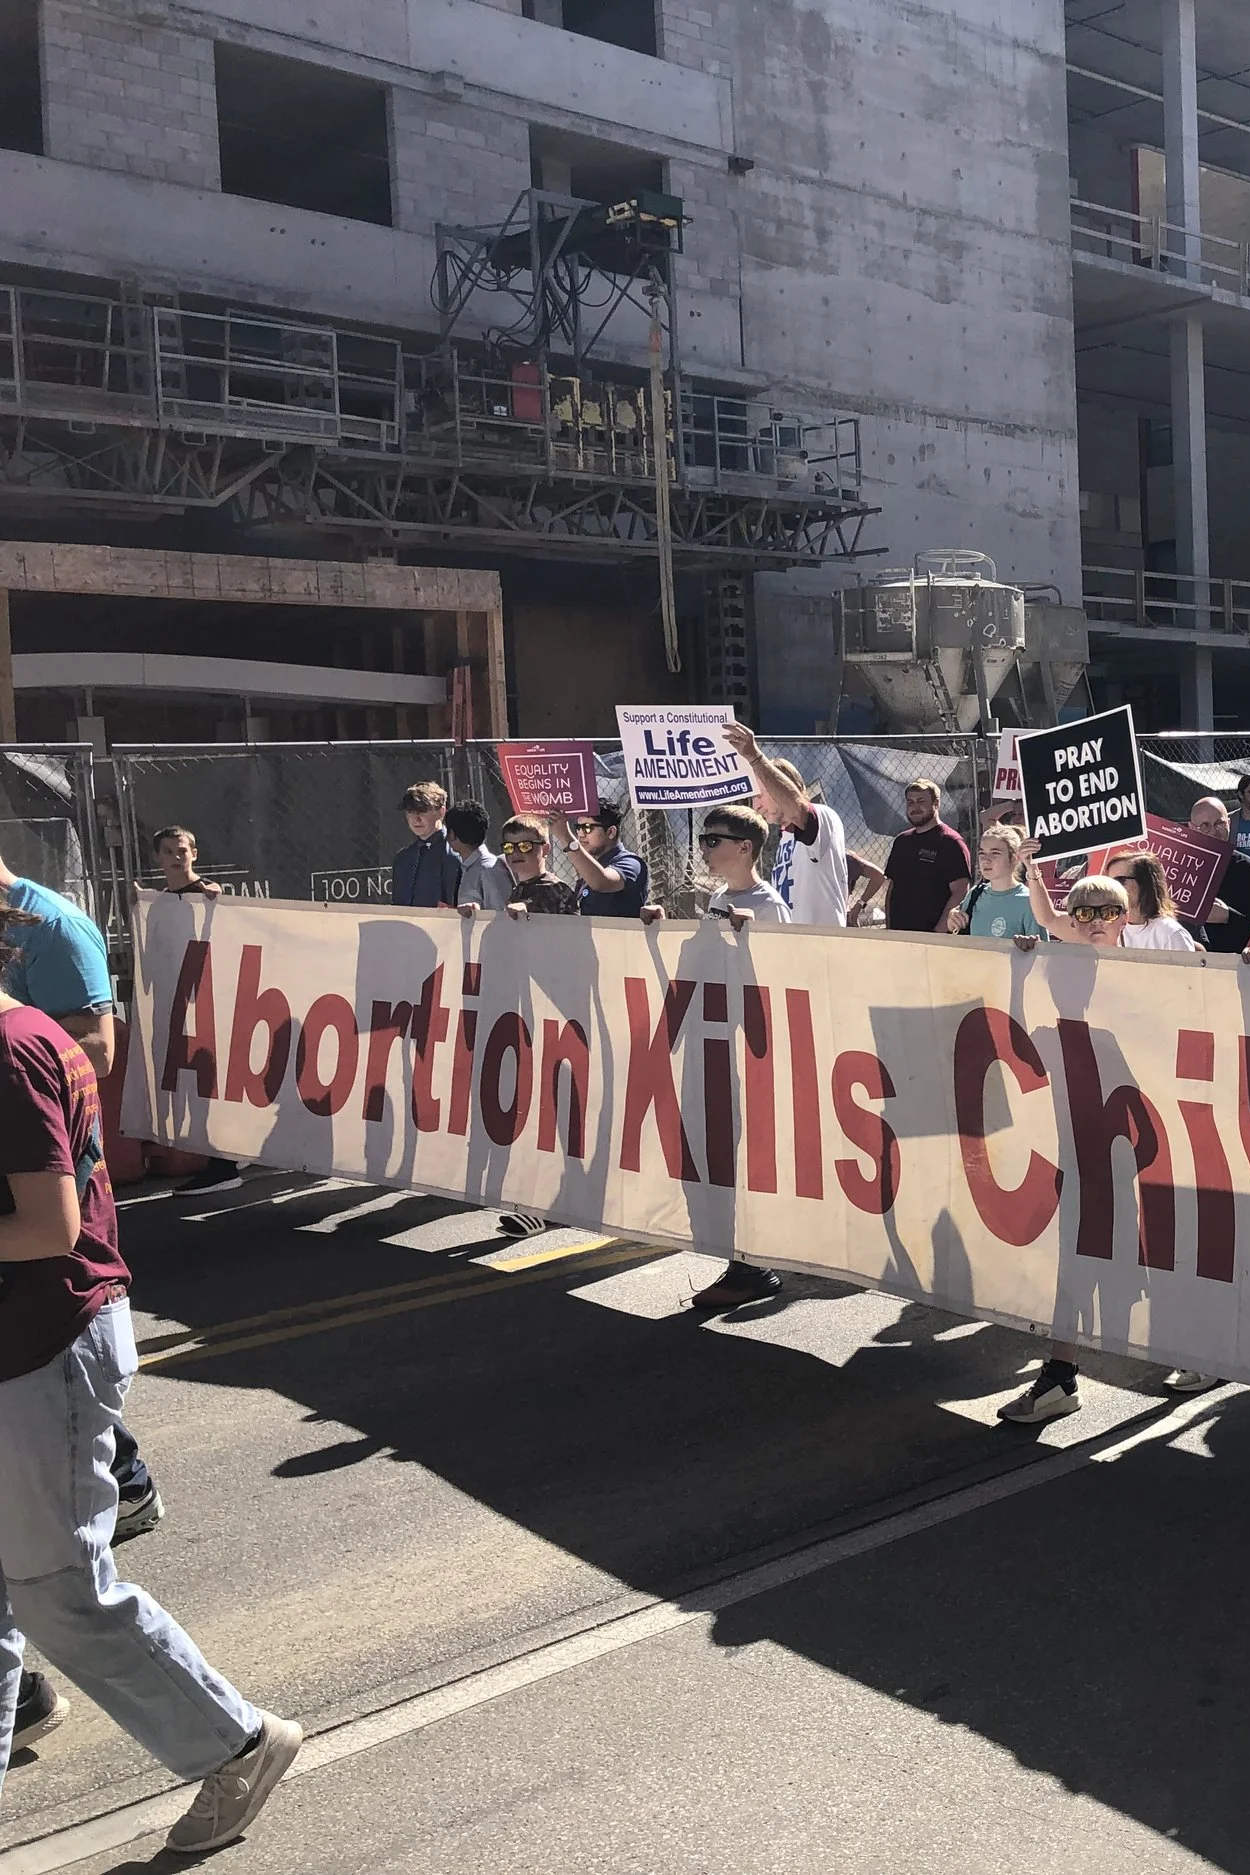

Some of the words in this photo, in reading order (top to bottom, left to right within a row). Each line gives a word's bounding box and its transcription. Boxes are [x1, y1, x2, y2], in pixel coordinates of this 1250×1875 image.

[623, 712, 657, 725] Support
[666, 712, 728, 724] Constitutional
[644, 730, 717, 757] Life
[635, 752, 739, 779] AMENDMENT
[1054, 737, 1103, 773] PRAY
[514, 763, 569, 779] EQUALITY
[518, 778, 552, 790] BEGINS
[556, 777, 571, 789] IN
[638, 781, 748, 801] www.LifeAmendment.org
[1045, 778, 1074, 805] TO
[1078, 766, 1119, 798] END
[522, 793, 531, 802] THE
[530, 790, 573, 806] WOMB
[1034, 792, 1138, 839] ABORTION
[1127, 839, 1205, 871] QUALITY
[322, 877, 361, 899] 100
[1181, 872, 1198, 887] IN
[1167, 884, 1192, 903] MB
[161, 940, 591, 1158] Abortion
[619, 976, 902, 1214] Kills
